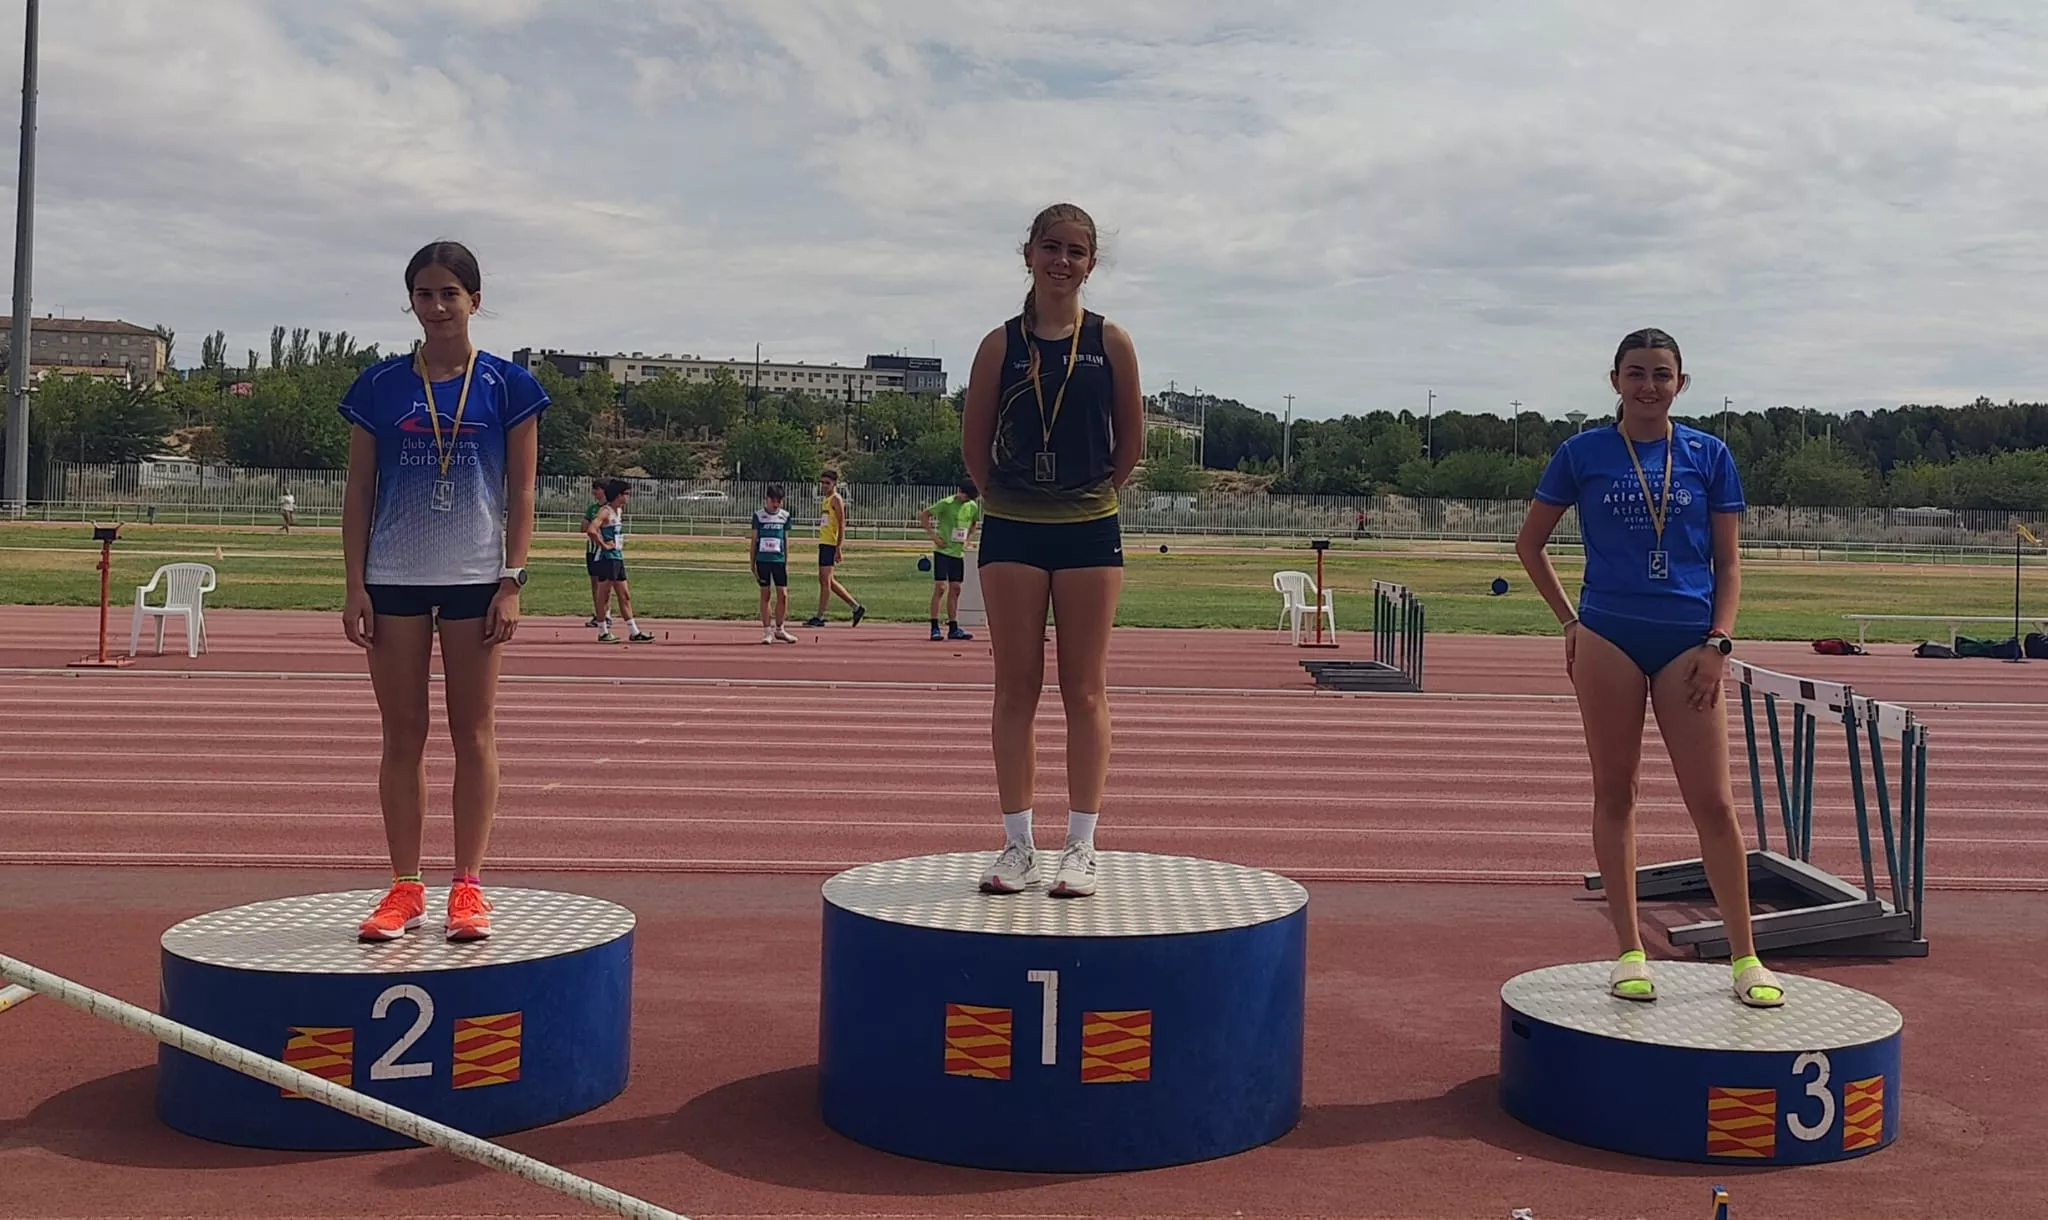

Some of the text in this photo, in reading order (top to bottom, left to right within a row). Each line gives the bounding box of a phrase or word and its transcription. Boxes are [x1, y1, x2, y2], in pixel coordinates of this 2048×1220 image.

[402, 436, 480, 450] Club Aleismo
[1612, 480, 1681, 489] Atleiso
[1603, 489, 1692, 506] Atletsmo
[1612, 506, 1682, 516] Atletsmo
[1624, 516, 1673, 524] Atletio
[1027, 970, 1059, 1065] 1
[370, 984, 434, 1080] 2
[1786, 1051, 1836, 1141] 3
